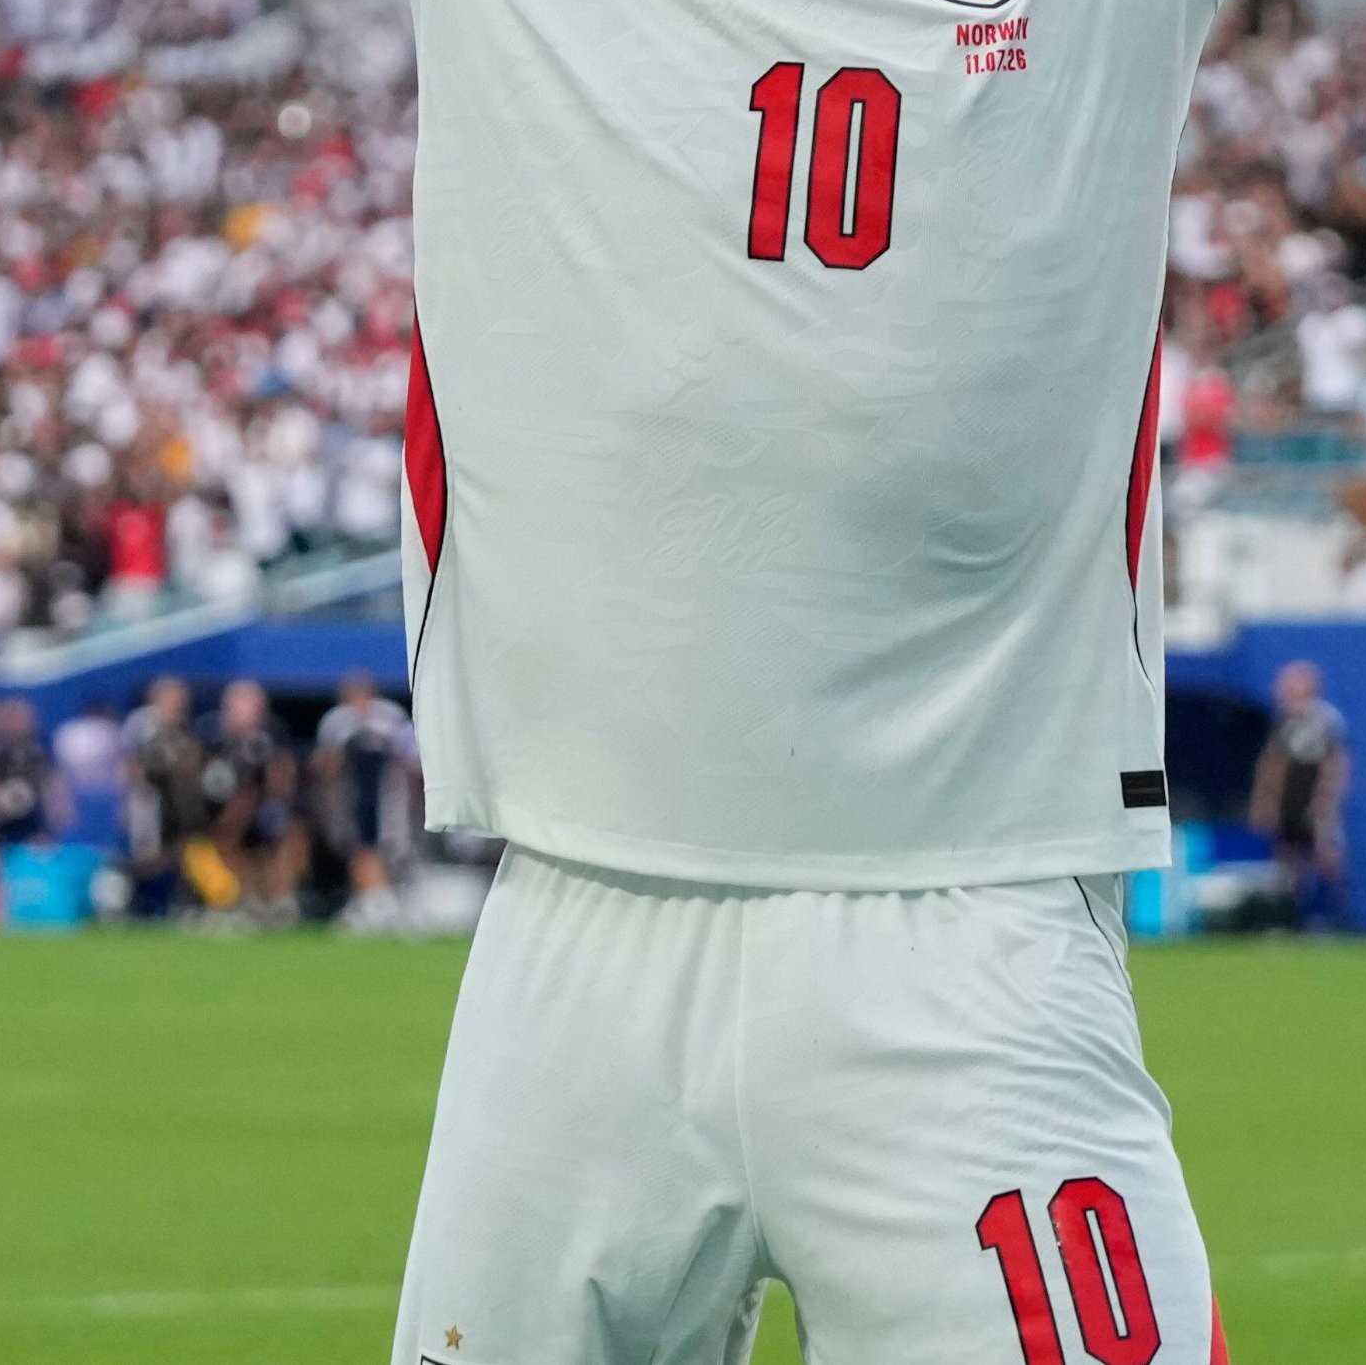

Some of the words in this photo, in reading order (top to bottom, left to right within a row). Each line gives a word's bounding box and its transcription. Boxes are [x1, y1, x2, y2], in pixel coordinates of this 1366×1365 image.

[965, 48, 1027, 75] 11.07.26
[748, 61, 902, 270] 10
[975, 1176, 1162, 1365] 10
